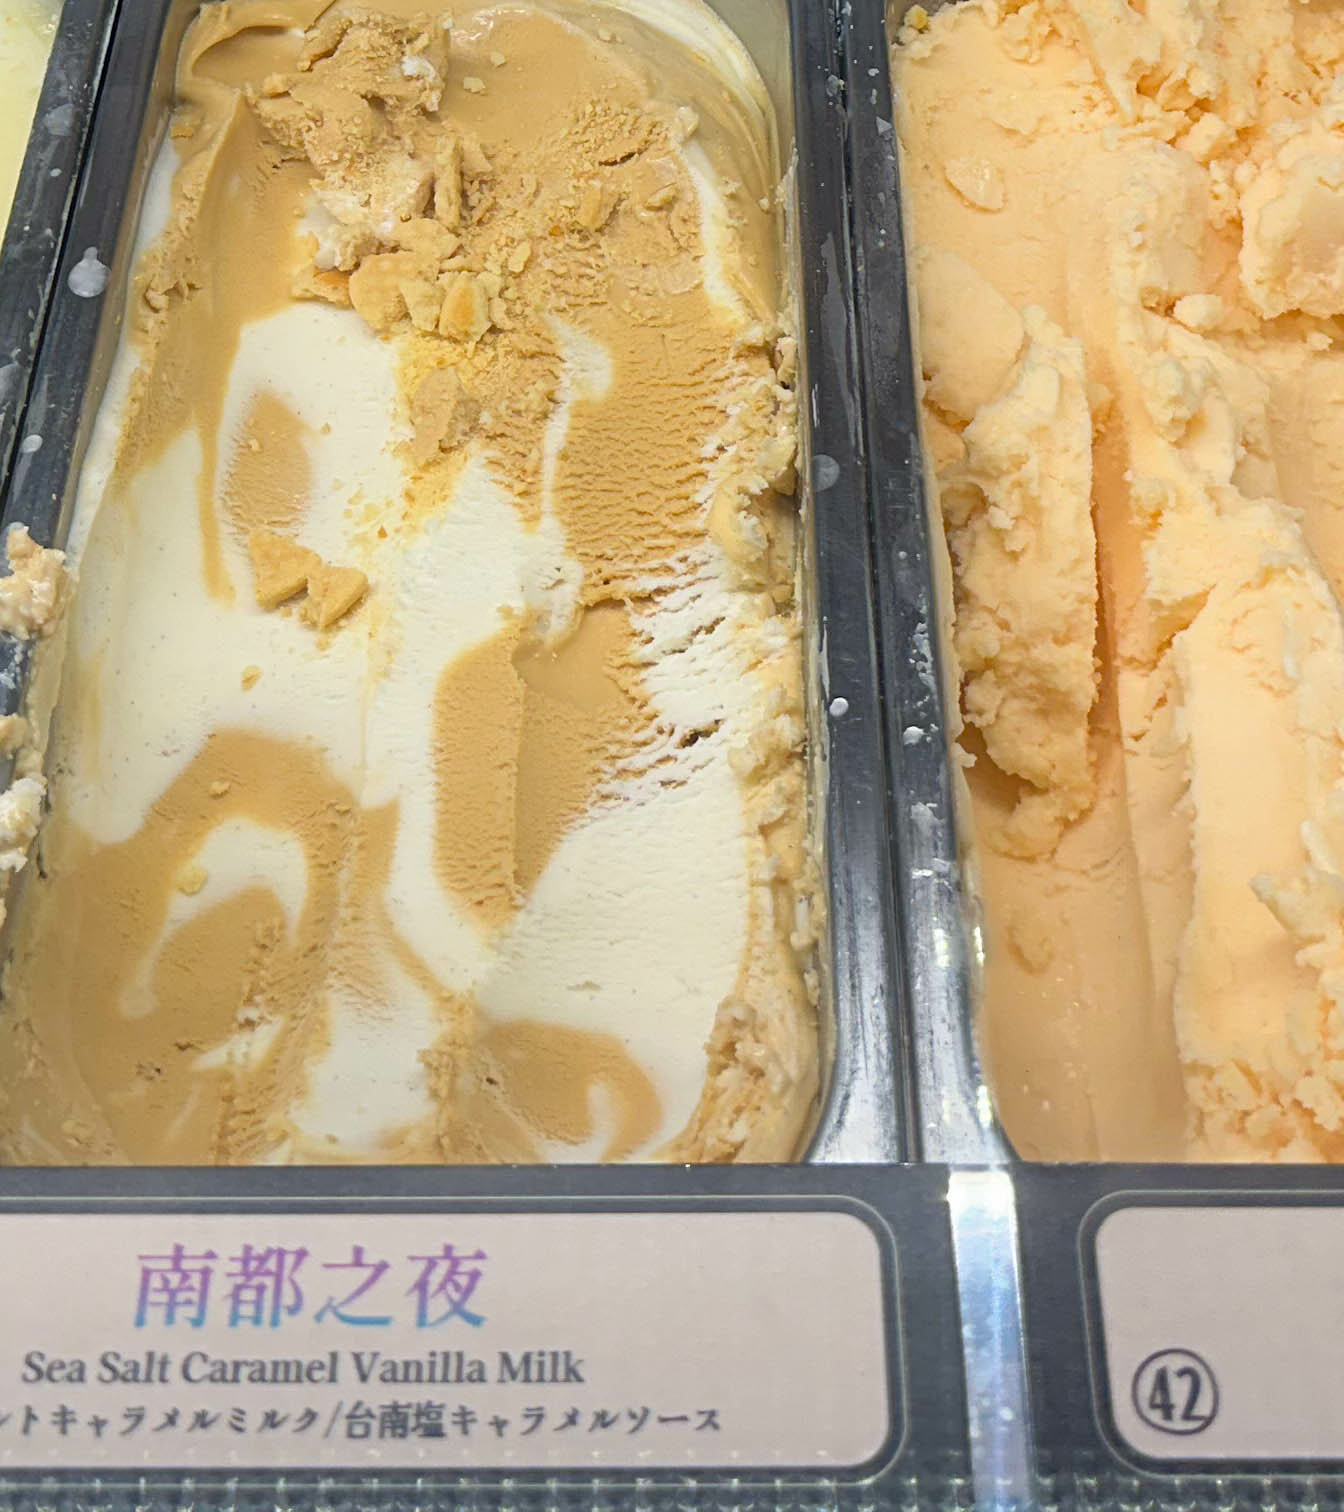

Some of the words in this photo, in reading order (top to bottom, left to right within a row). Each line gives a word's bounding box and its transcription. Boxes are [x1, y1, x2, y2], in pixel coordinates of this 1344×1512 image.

[133, 1242, 488, 1329] 南都之夜
[21, 1351, 86, 1386] Sea
[96, 1350, 170, 1385] Salt
[181, 1350, 339, 1385] Caramel
[350, 1350, 488, 1385] Vanilla
[496, 1350, 586, 1384] Milk
[1146, 1363, 1213, 1424] 42
